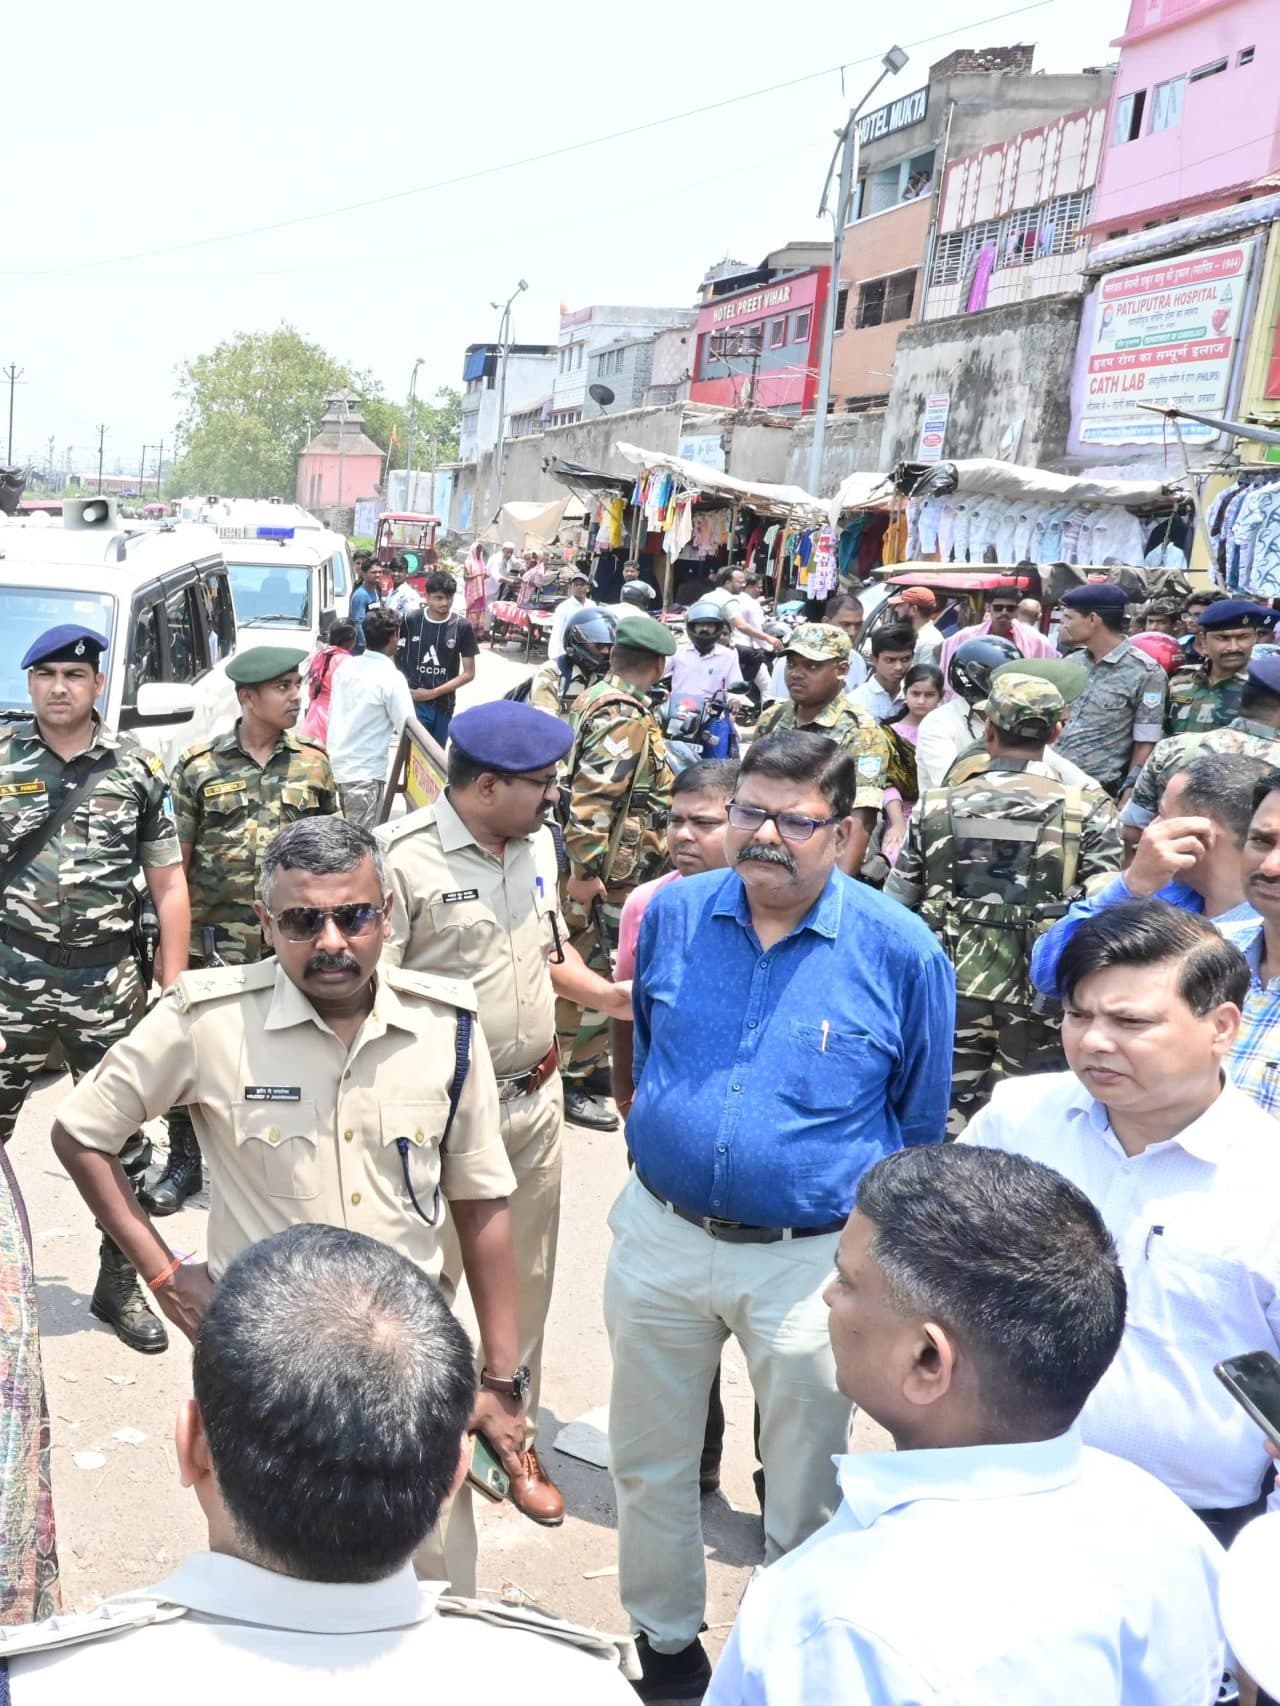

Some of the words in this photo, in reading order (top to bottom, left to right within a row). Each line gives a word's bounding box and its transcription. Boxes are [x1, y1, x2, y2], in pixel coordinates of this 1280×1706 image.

[889, 89, 926, 131] MUKTA
[713, 303, 737, 323] HOTEL
[737, 295, 763, 316] PREET
[764, 286, 791, 309] VIHAR
[1116, 293, 1170, 317] PATLIPUTRA
[1173, 286, 1218, 308] HOSPITAL
[1118, 353, 1135, 366] रोग
[1139, 353, 1152, 362] का
[1156, 343, 1188, 363] सम्पूर्ण
[1192, 343, 1225, 358] इलाज
[1090, 375, 1120, 395] CATH
[1122, 372, 1146, 392] LAB
